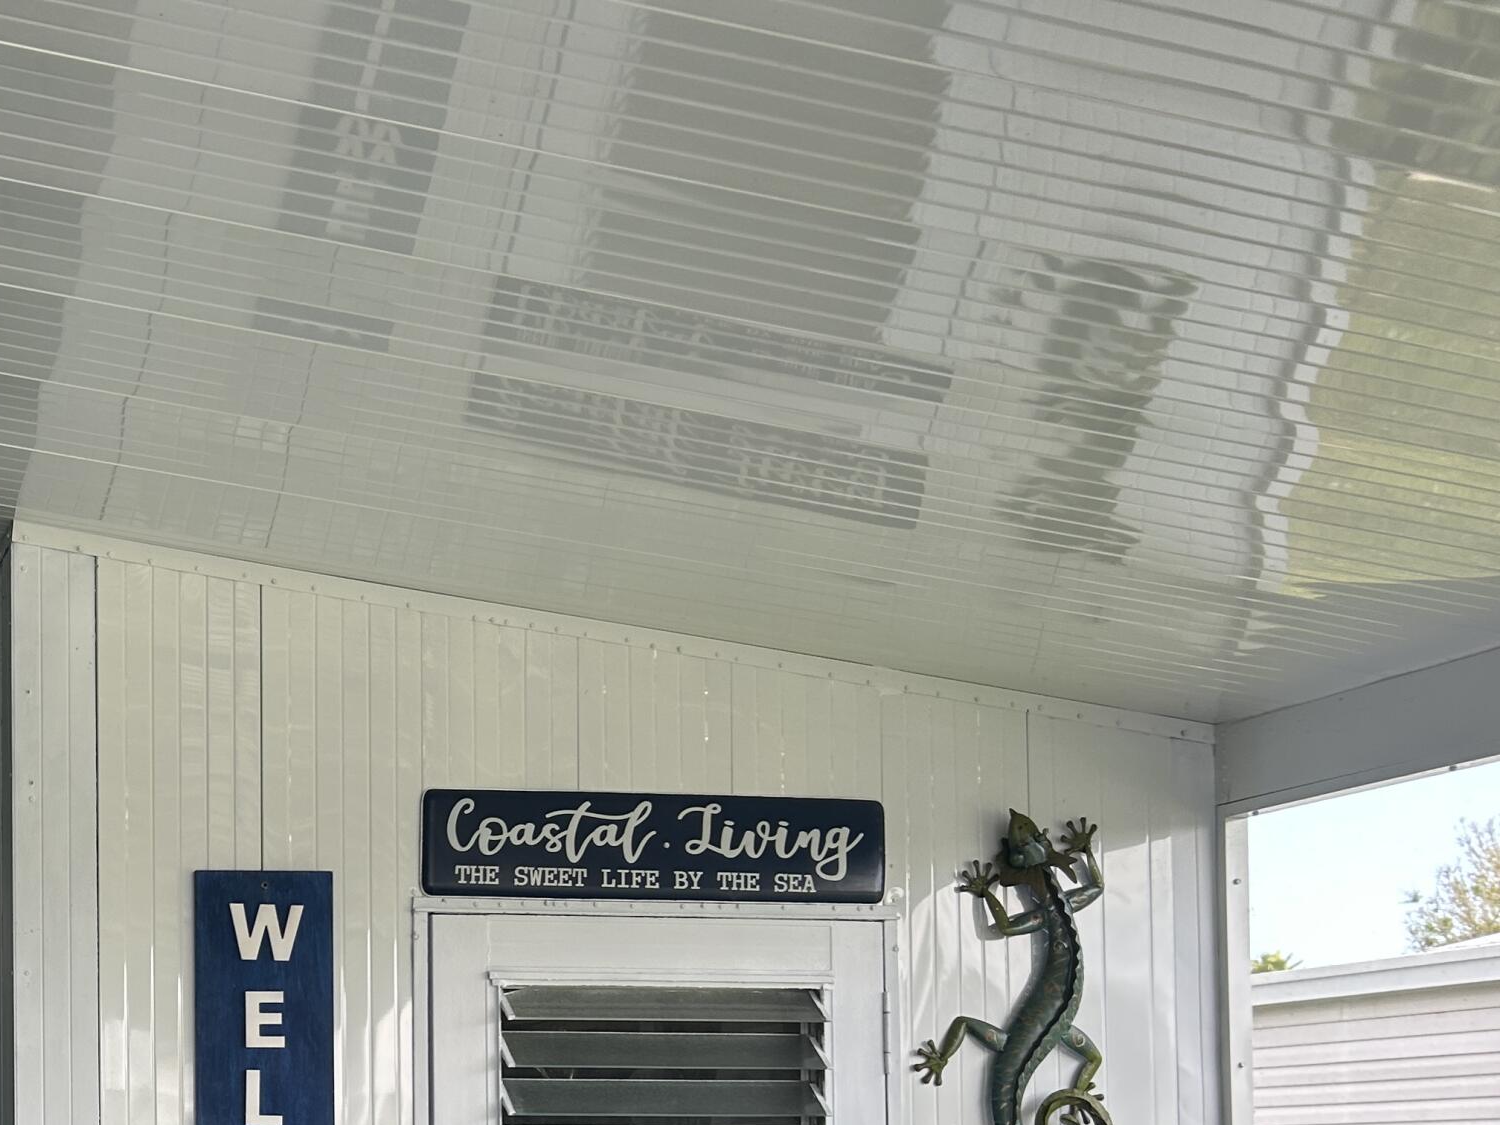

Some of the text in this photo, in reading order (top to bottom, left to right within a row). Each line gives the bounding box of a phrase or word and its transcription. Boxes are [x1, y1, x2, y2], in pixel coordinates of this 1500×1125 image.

[447, 798, 864, 881] Coastal Living
[455, 865, 817, 893] THE SWEET LIFE BY THE SEA
